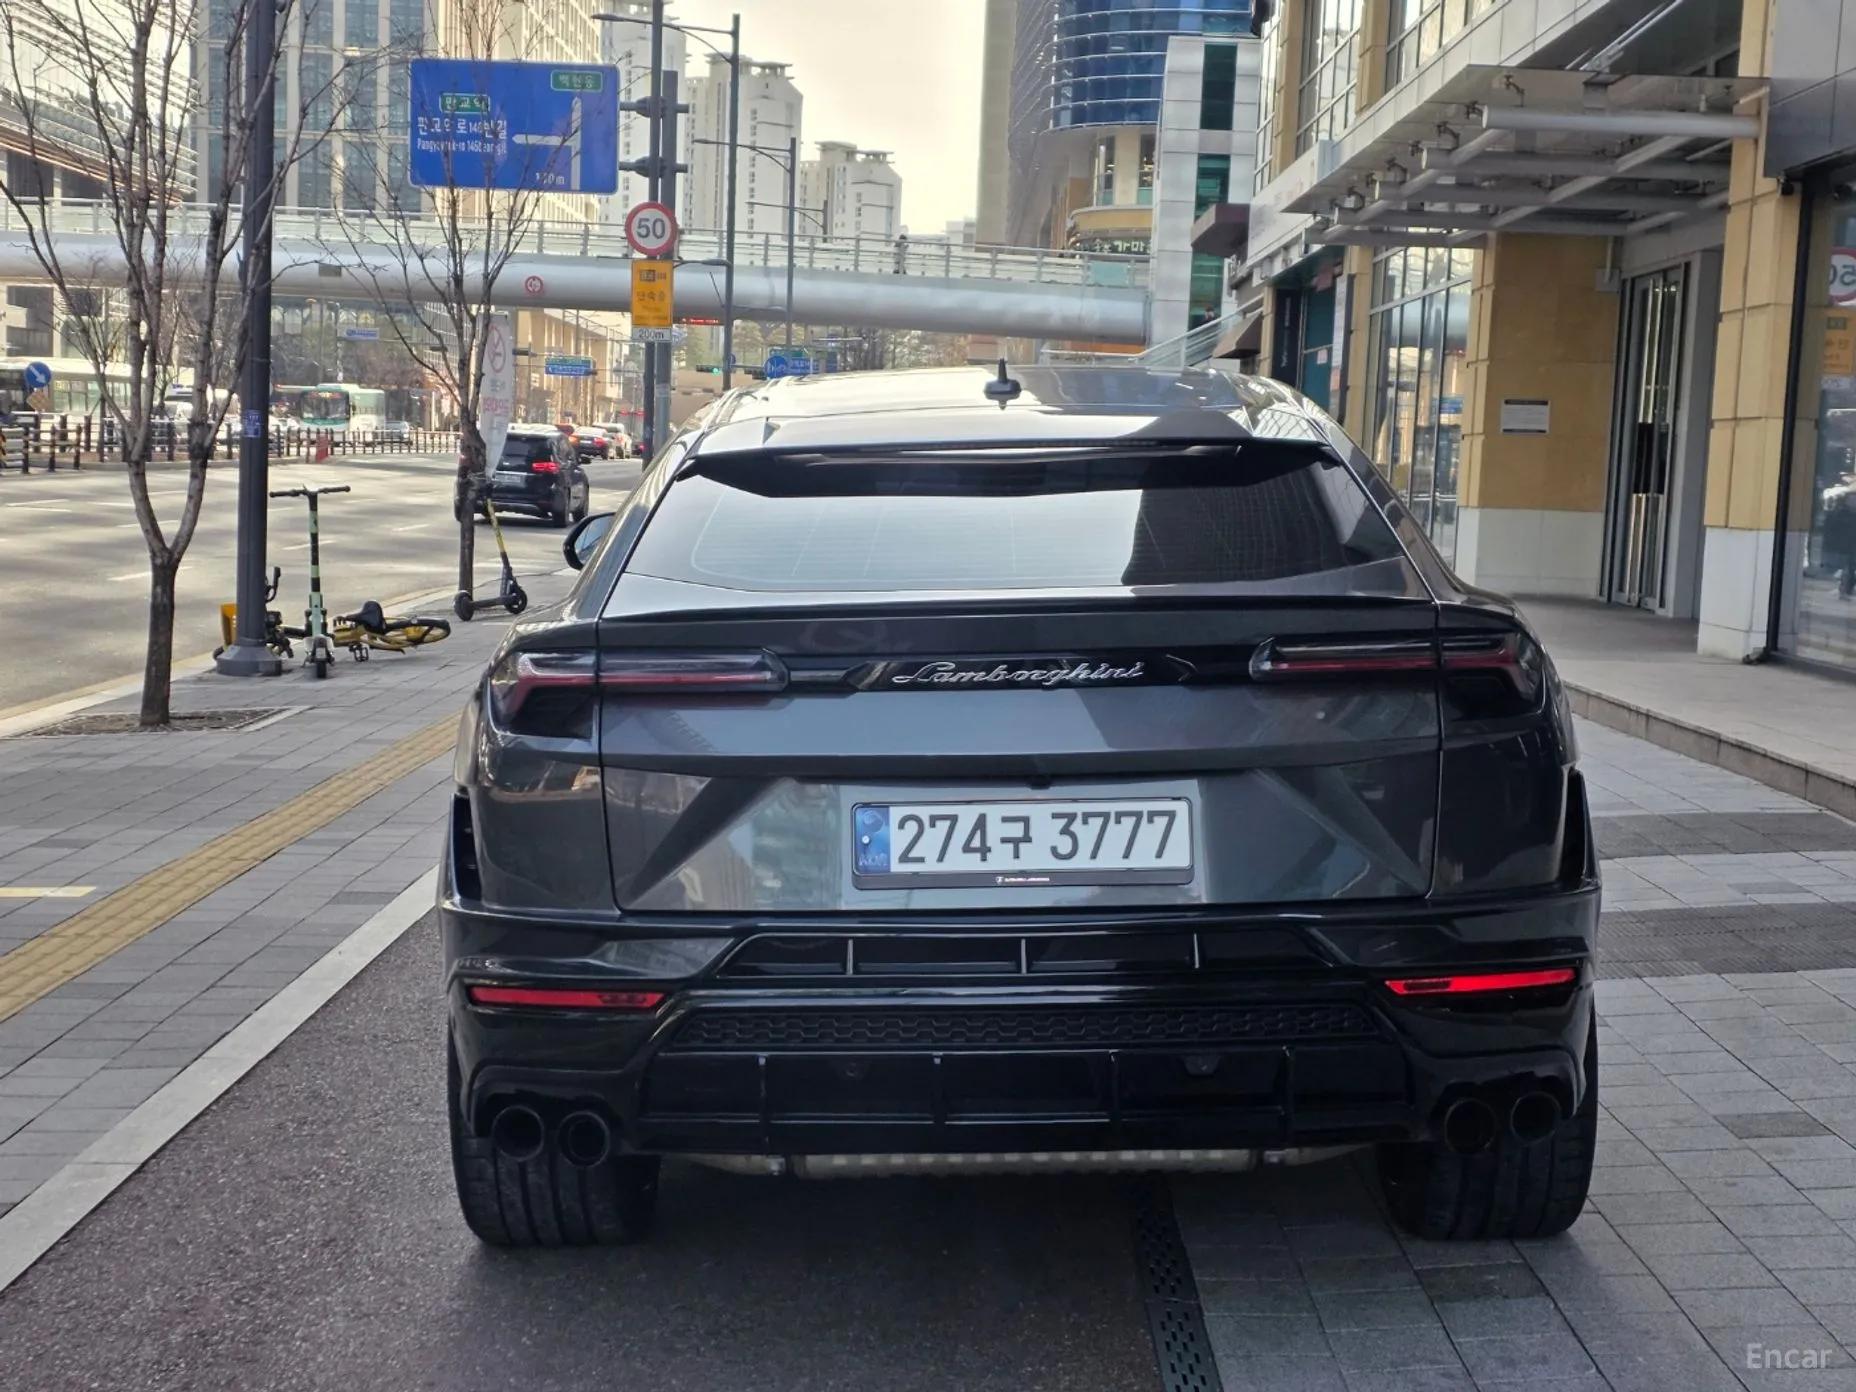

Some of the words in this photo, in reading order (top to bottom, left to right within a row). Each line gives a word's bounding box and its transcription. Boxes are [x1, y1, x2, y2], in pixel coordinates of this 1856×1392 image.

[636, 217, 666, 239] 50
[892, 660, 1145, 690] Lamborghini
[897, 812, 1033, 864] 274구
[1050, 809, 1177, 861] 3777
